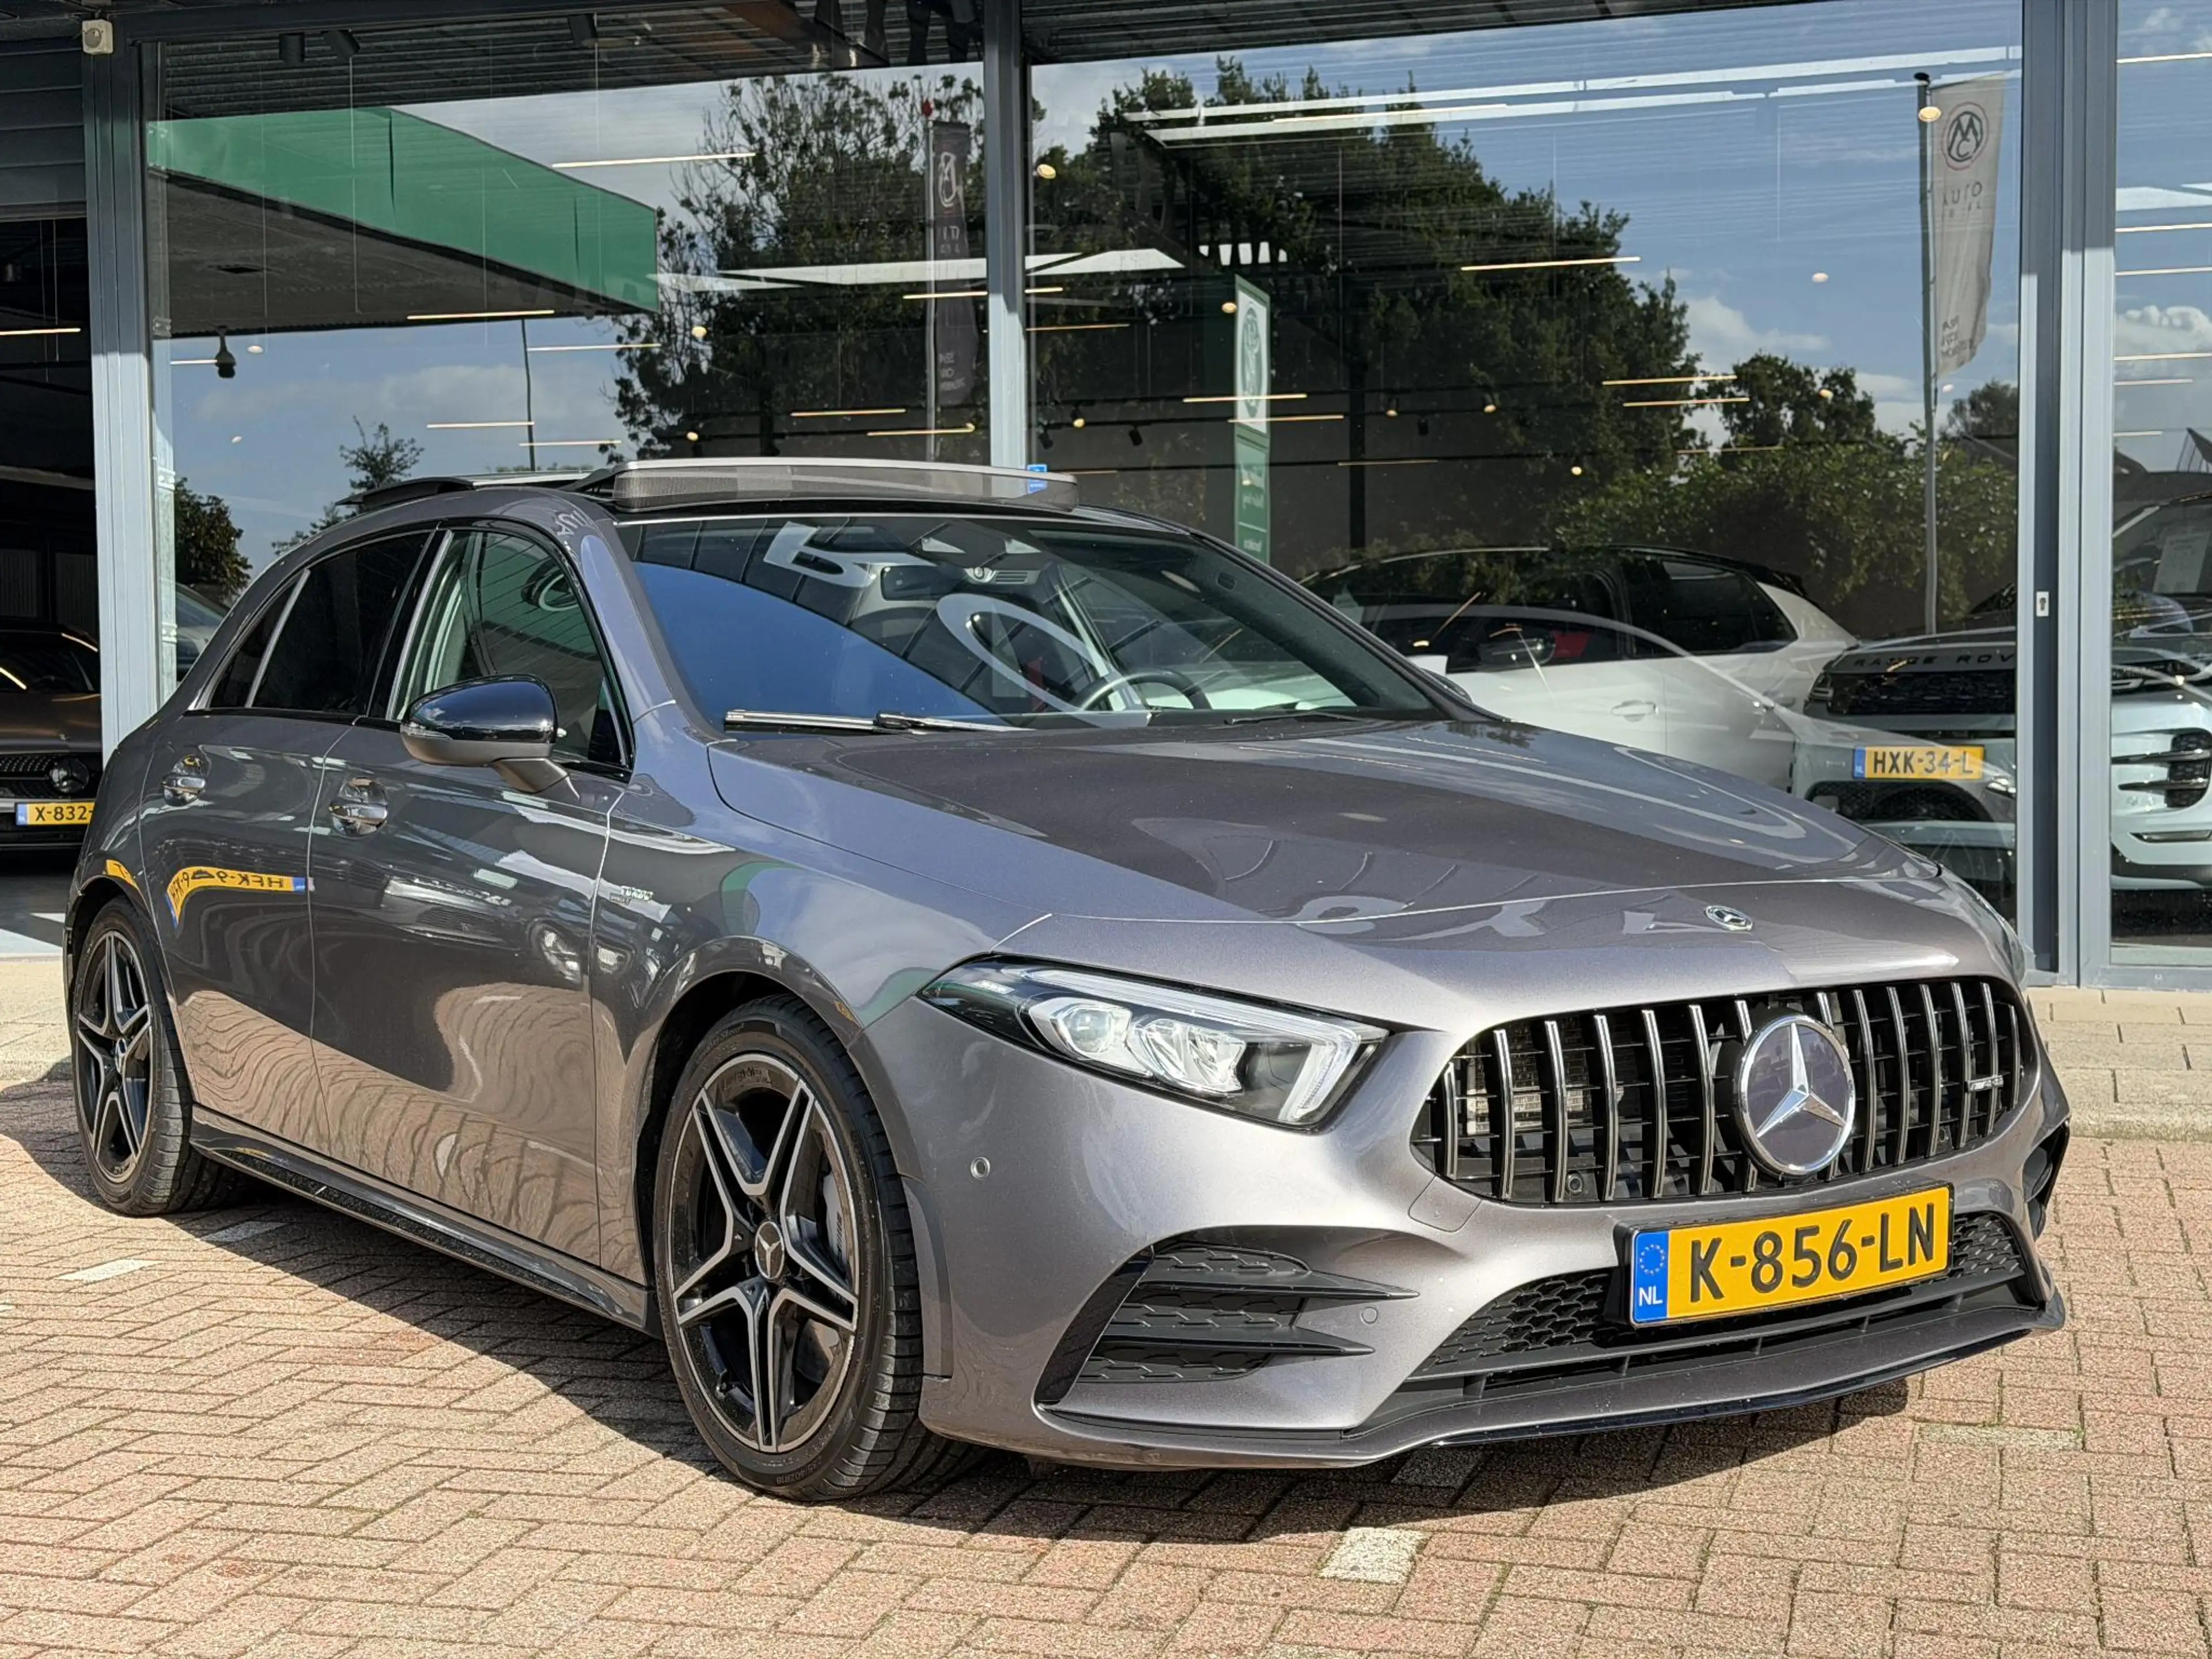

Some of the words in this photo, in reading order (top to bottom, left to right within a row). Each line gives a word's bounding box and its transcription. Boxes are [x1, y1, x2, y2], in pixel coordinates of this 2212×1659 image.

[1873, 750, 1974, 774] HXK-34-L
[1690, 1203, 1934, 1303] K-856-LN
[1638, 1287, 1663, 1306] NL
